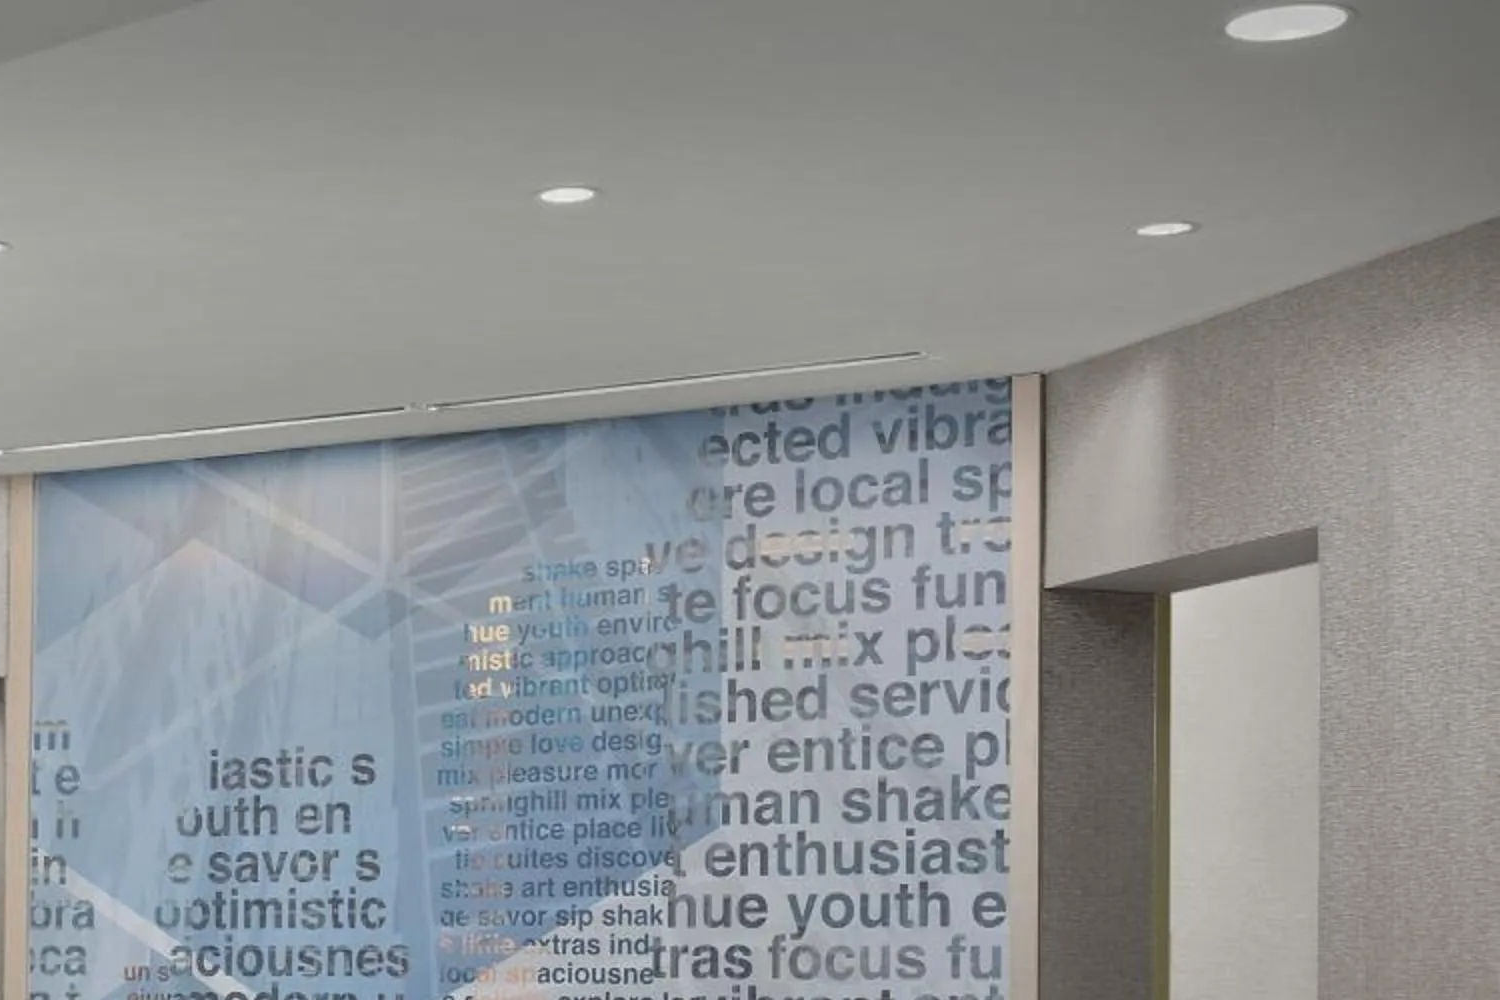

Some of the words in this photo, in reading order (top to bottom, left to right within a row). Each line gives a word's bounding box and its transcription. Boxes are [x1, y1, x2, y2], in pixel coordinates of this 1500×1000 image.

[701, 411, 851, 467] ected
[872, 403, 1012, 455] vibra
[795, 457, 929, 513] local
[951, 463, 1012, 512] sp
[666, 582, 717, 625] te
[732, 575, 892, 620] focus
[911, 563, 1007, 610] fun
[517, 613, 588, 645] youth
[530, 731, 583, 755] love
[766, 724, 945, 773] entice
[55, 764, 81, 795] e
[208, 747, 335, 790] iastic
[350, 753, 377, 786] s
[294, 800, 352, 835] en
[576, 788, 622, 811] mix
[841, 774, 1012, 823] shake
[573, 816, 643, 845] place
[207, 849, 340, 885] savor
[355, 849, 381, 882] s
[704, 827, 1011, 878] enthusiast
[154, 887, 388, 931] optimistic
[521, 878, 556, 899] art
[666, 880, 769, 929] hue
[787, 880, 951, 940] youth
[971, 889, 1008, 929] e
[555, 903, 594, 931] sip
[602, 902, 664, 928] shak
[650, 934, 753, 981] tras
[766, 933, 928, 981] focus
[945, 933, 1004, 980] fu
